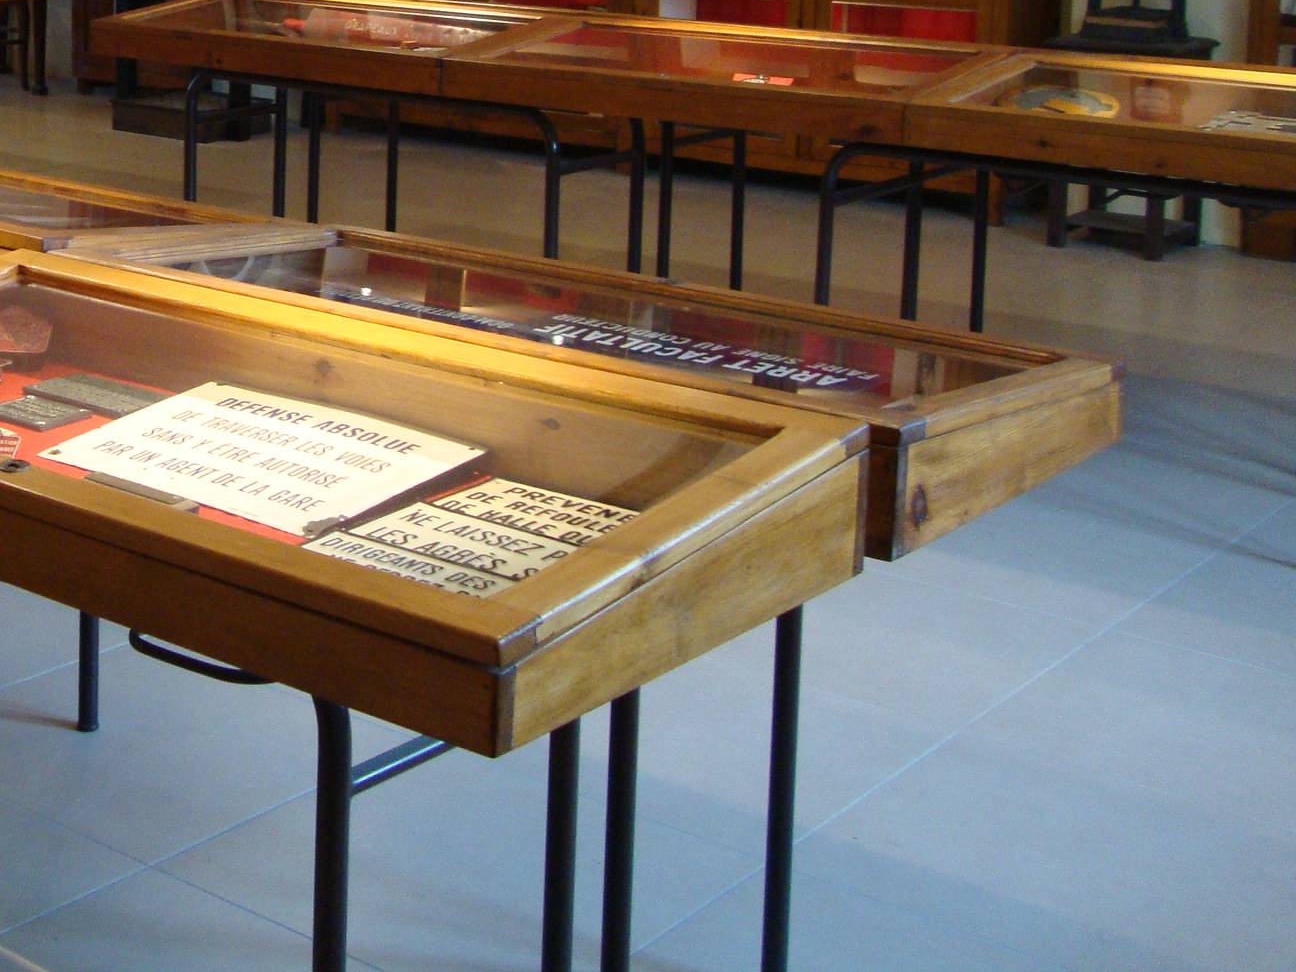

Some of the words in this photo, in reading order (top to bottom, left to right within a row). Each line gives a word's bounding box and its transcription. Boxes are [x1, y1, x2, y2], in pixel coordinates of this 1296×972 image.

[552, 313, 691, 344] CONDUCTEUR
[533, 324, 724, 365] FACULTATIF
[692, 342, 731, 352] AU
[731, 349, 803, 365] SIGNE
[722, 359, 848, 386] ARRET
[806, 362, 879, 380] FAIRE
[142, 427, 194, 445] SANS
[192, 439, 213, 449] Y
[171, 410, 203, 423] DE
[201, 416, 299, 447] TRAVERSER
[294, 440, 334, 456] LES
[334, 451, 392, 473] VOIES
[214, 397, 314, 424] DEFENSE
[311, 420, 421, 455] ABSOLUE
[92, 440, 134, 456] PAR
[129, 450, 161, 463] UN
[155, 458, 219, 479] AGENT
[211, 473, 244, 488] DE
[238, 481, 270, 496] LA
[267, 489, 326, 512] GARE
[466, 492, 503, 505] DE
[440, 500, 476, 513] DE
[478, 509, 557, 534] HALLE
[366, 526, 418, 546] LES
[400, 511, 441, 527] NE
[432, 521, 545, 555] LAISSEZ
[320, 537, 444, 576] DIRIGEANTS
[444, 572, 496, 591] DES
